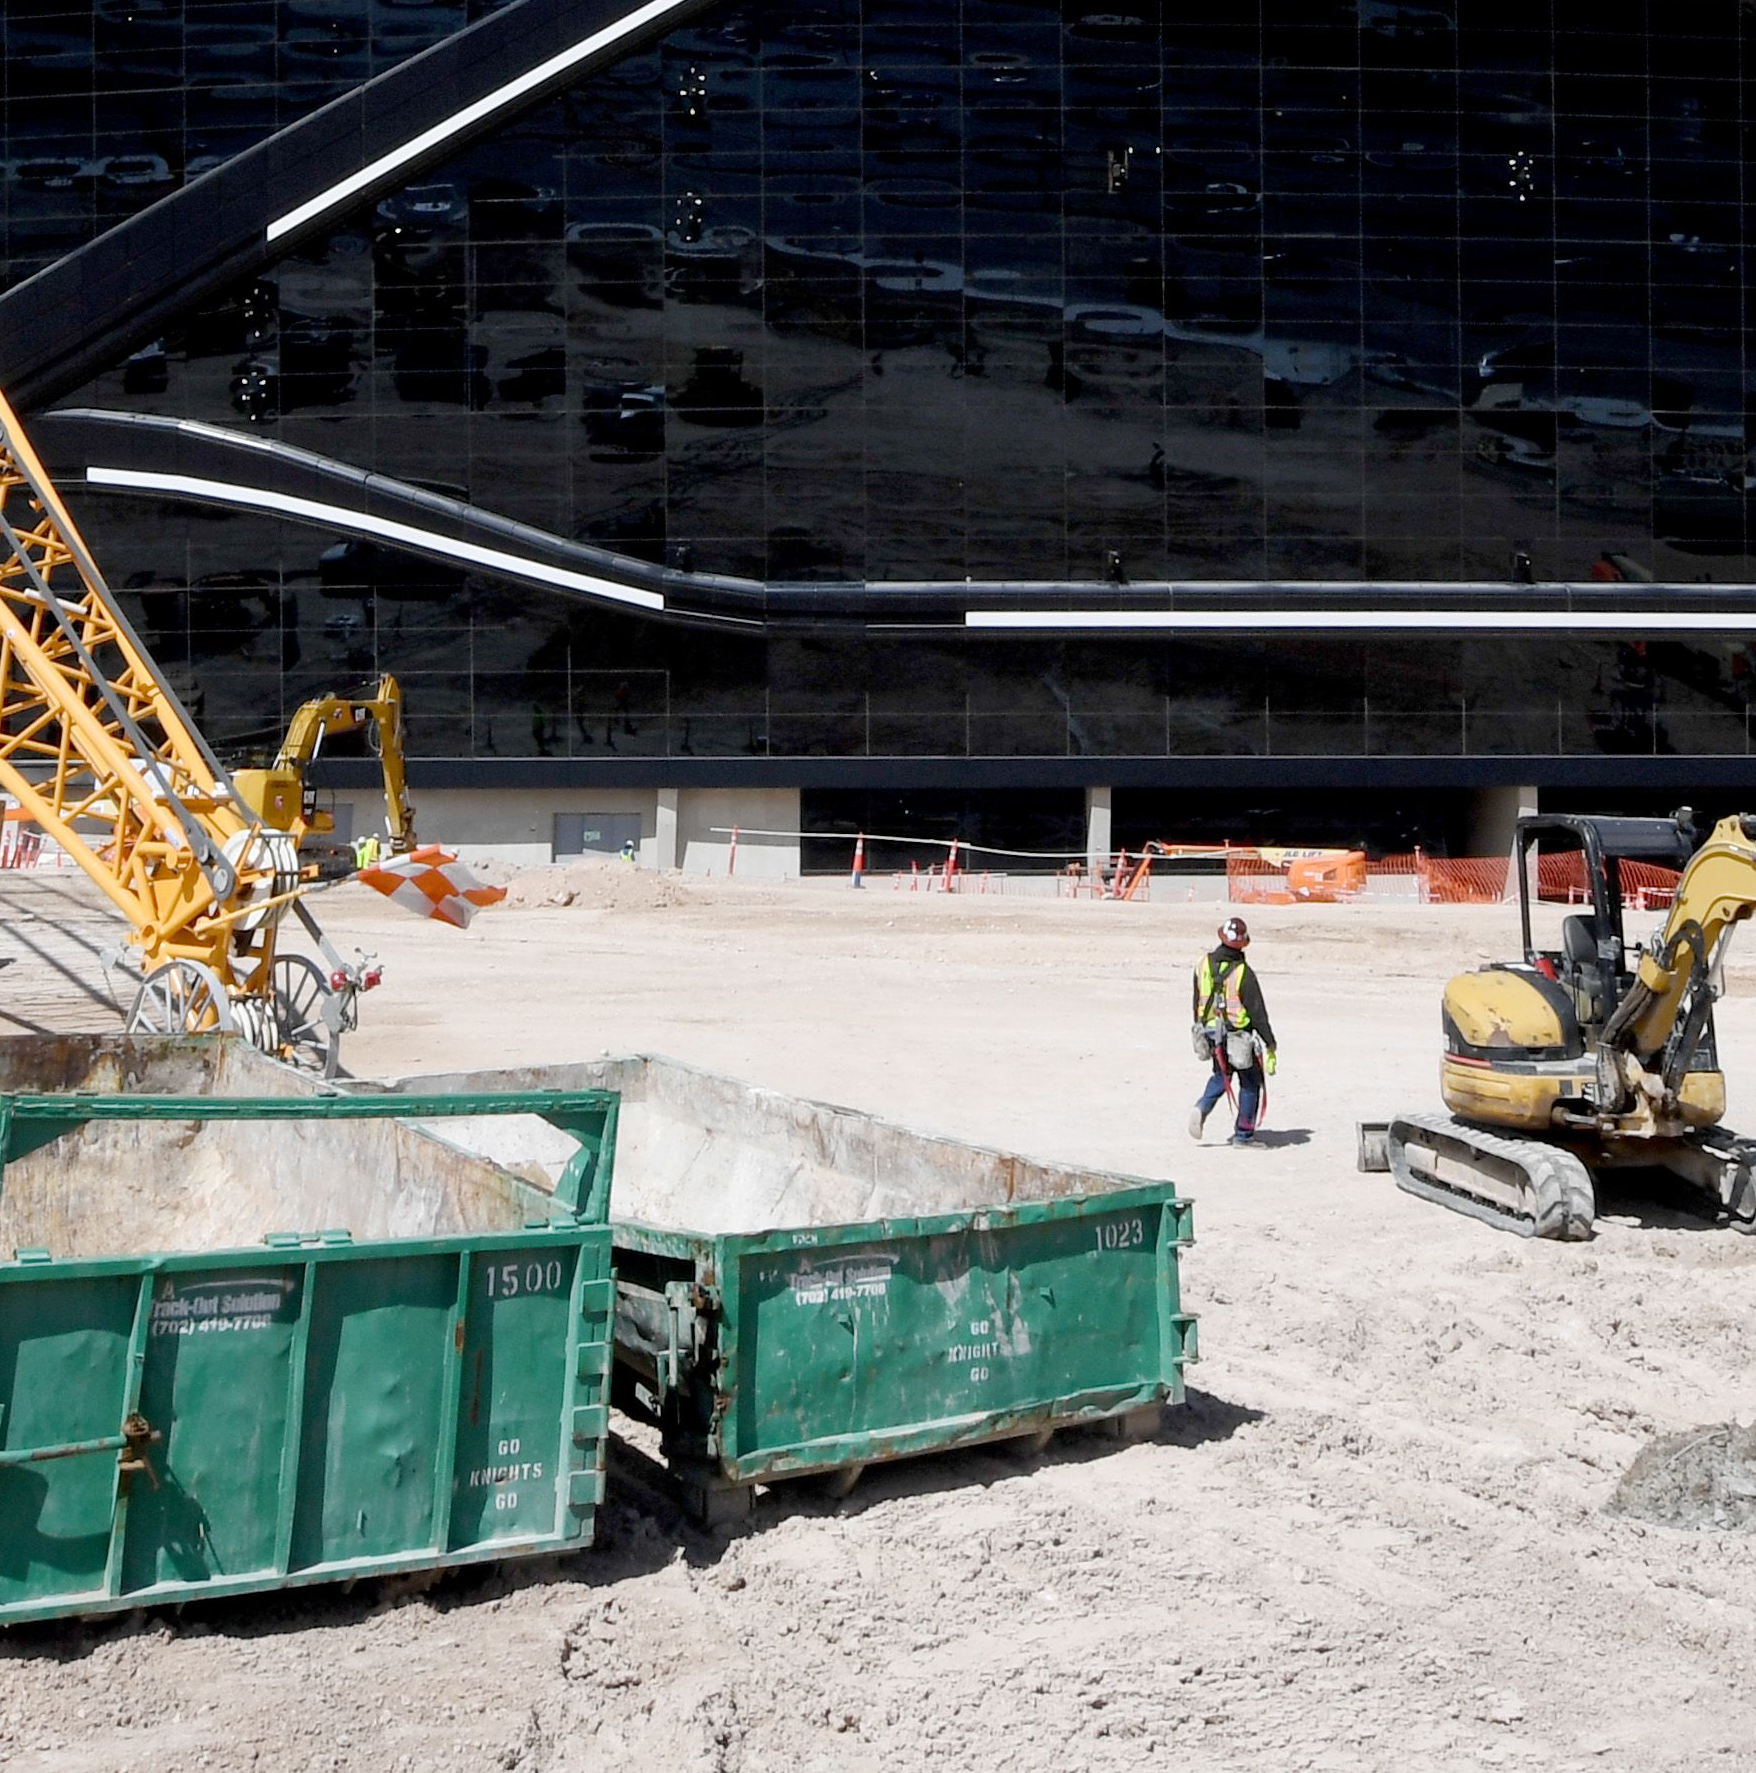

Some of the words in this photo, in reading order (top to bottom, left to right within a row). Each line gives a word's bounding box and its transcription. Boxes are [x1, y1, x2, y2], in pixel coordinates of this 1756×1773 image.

[1095, 1219, 1143, 1251] 1023
[486, 1260, 562, 1297] 1500
[151, 1297, 219, 1318] rack-Out
[151, 1317, 194, 1336] (702)
[970, 1320, 990, 1336] GO
[969, 1367, 989, 1383] GO
[498, 1438, 520, 1455] GO
[469, 1462, 543, 1487] KNIGHTS
[495, 1492, 518, 1510] GO
